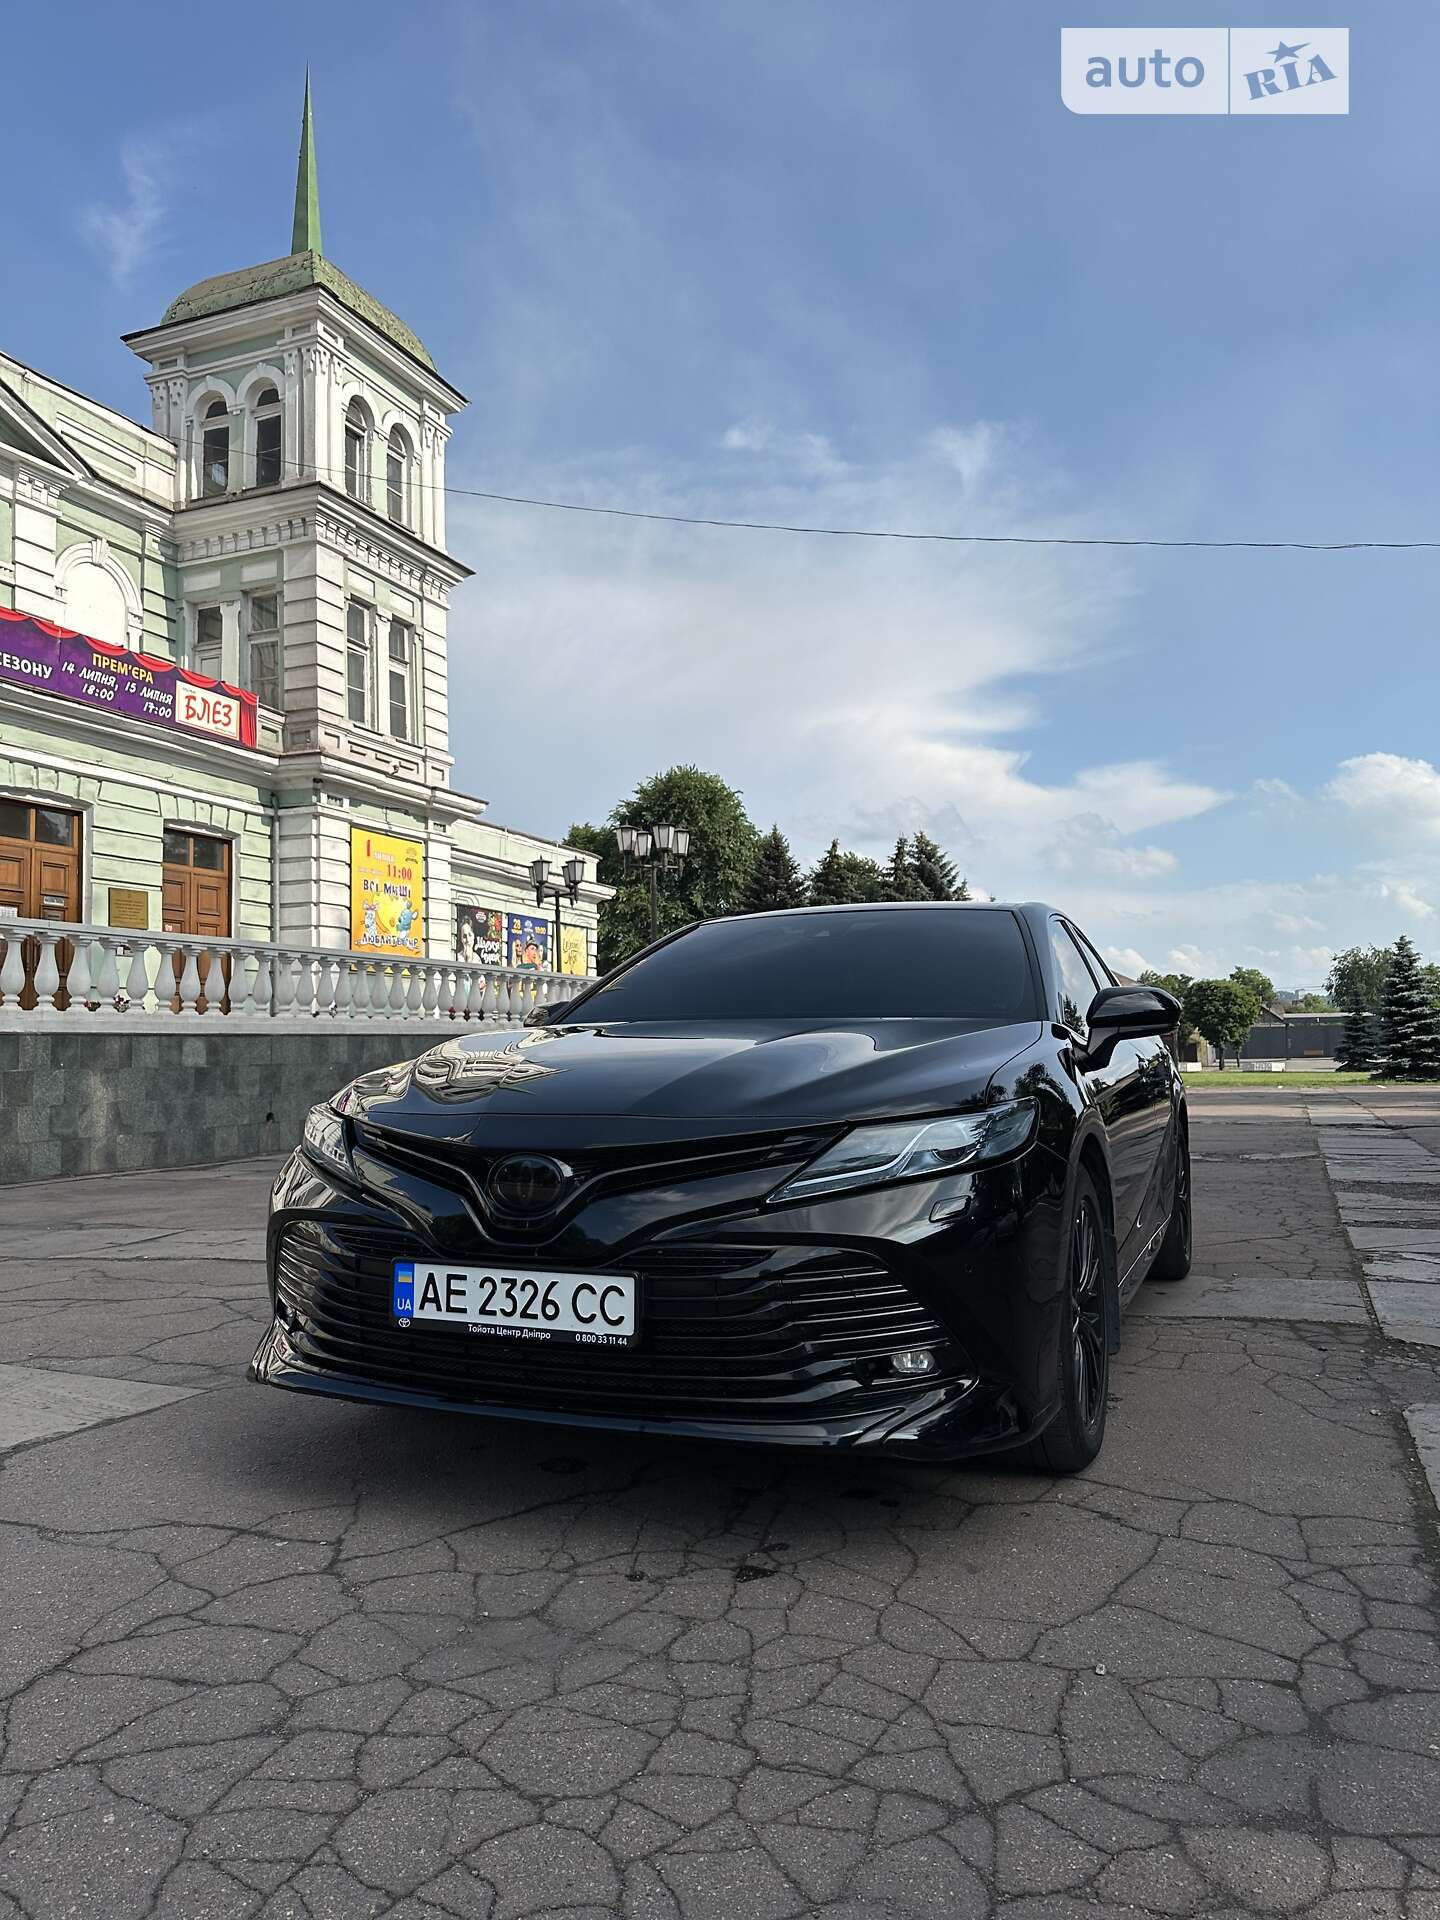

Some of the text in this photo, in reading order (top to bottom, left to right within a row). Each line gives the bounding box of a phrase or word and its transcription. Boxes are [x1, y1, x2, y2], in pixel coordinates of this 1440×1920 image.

[62, 661, 75, 674] 14
[79, 667, 119, 691] ЛИПНЯ,
[125, 681, 137, 693] 15
[139, 686, 174, 705] ЛИПНЯ
[82, 683, 114, 701] 18:00
[143, 702, 172, 718] 17:00
[388, 863, 412, 880] 11:00
[397, 1272, 625, 1326] UA AE 2326 CC
[468, 1324, 551, 1341] Тойота Центр Дніпро
[575, 1333, 627, 1346] 0 800 33 11 44
